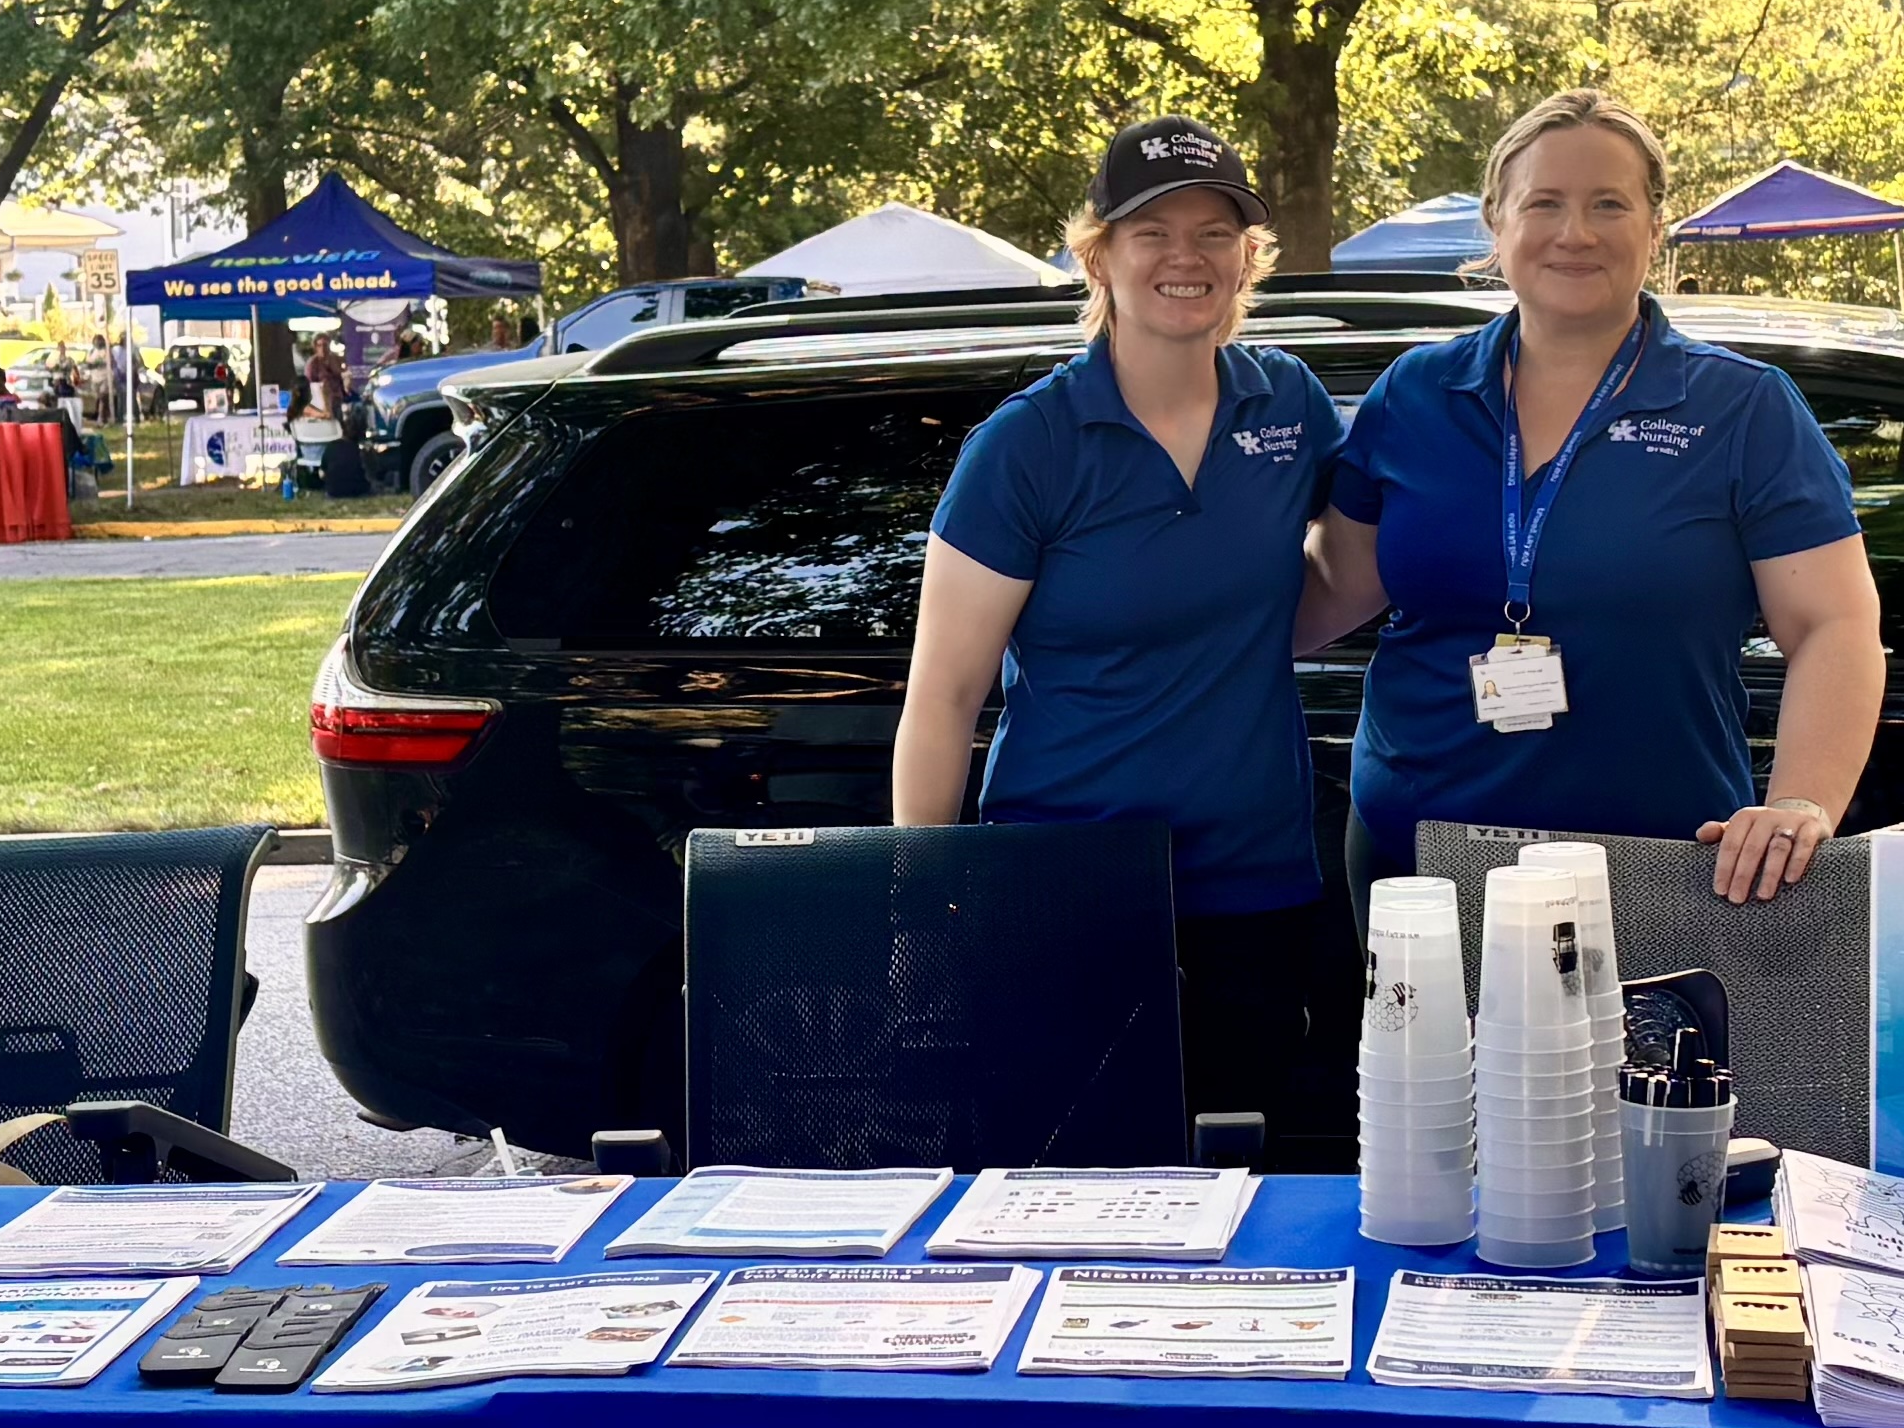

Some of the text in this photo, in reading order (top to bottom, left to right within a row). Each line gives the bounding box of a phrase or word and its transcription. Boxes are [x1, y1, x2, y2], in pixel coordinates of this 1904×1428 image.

[87, 252, 115, 262] SPEED
[90, 273, 116, 289] 35
[164, 270, 396, 296] We see the good ahead.
[1640, 419, 1705, 436] College of
[1639, 432, 1689, 448] Nursing
[745, 832, 804, 841] YETI
[1476, 828, 1539, 839] YETI
